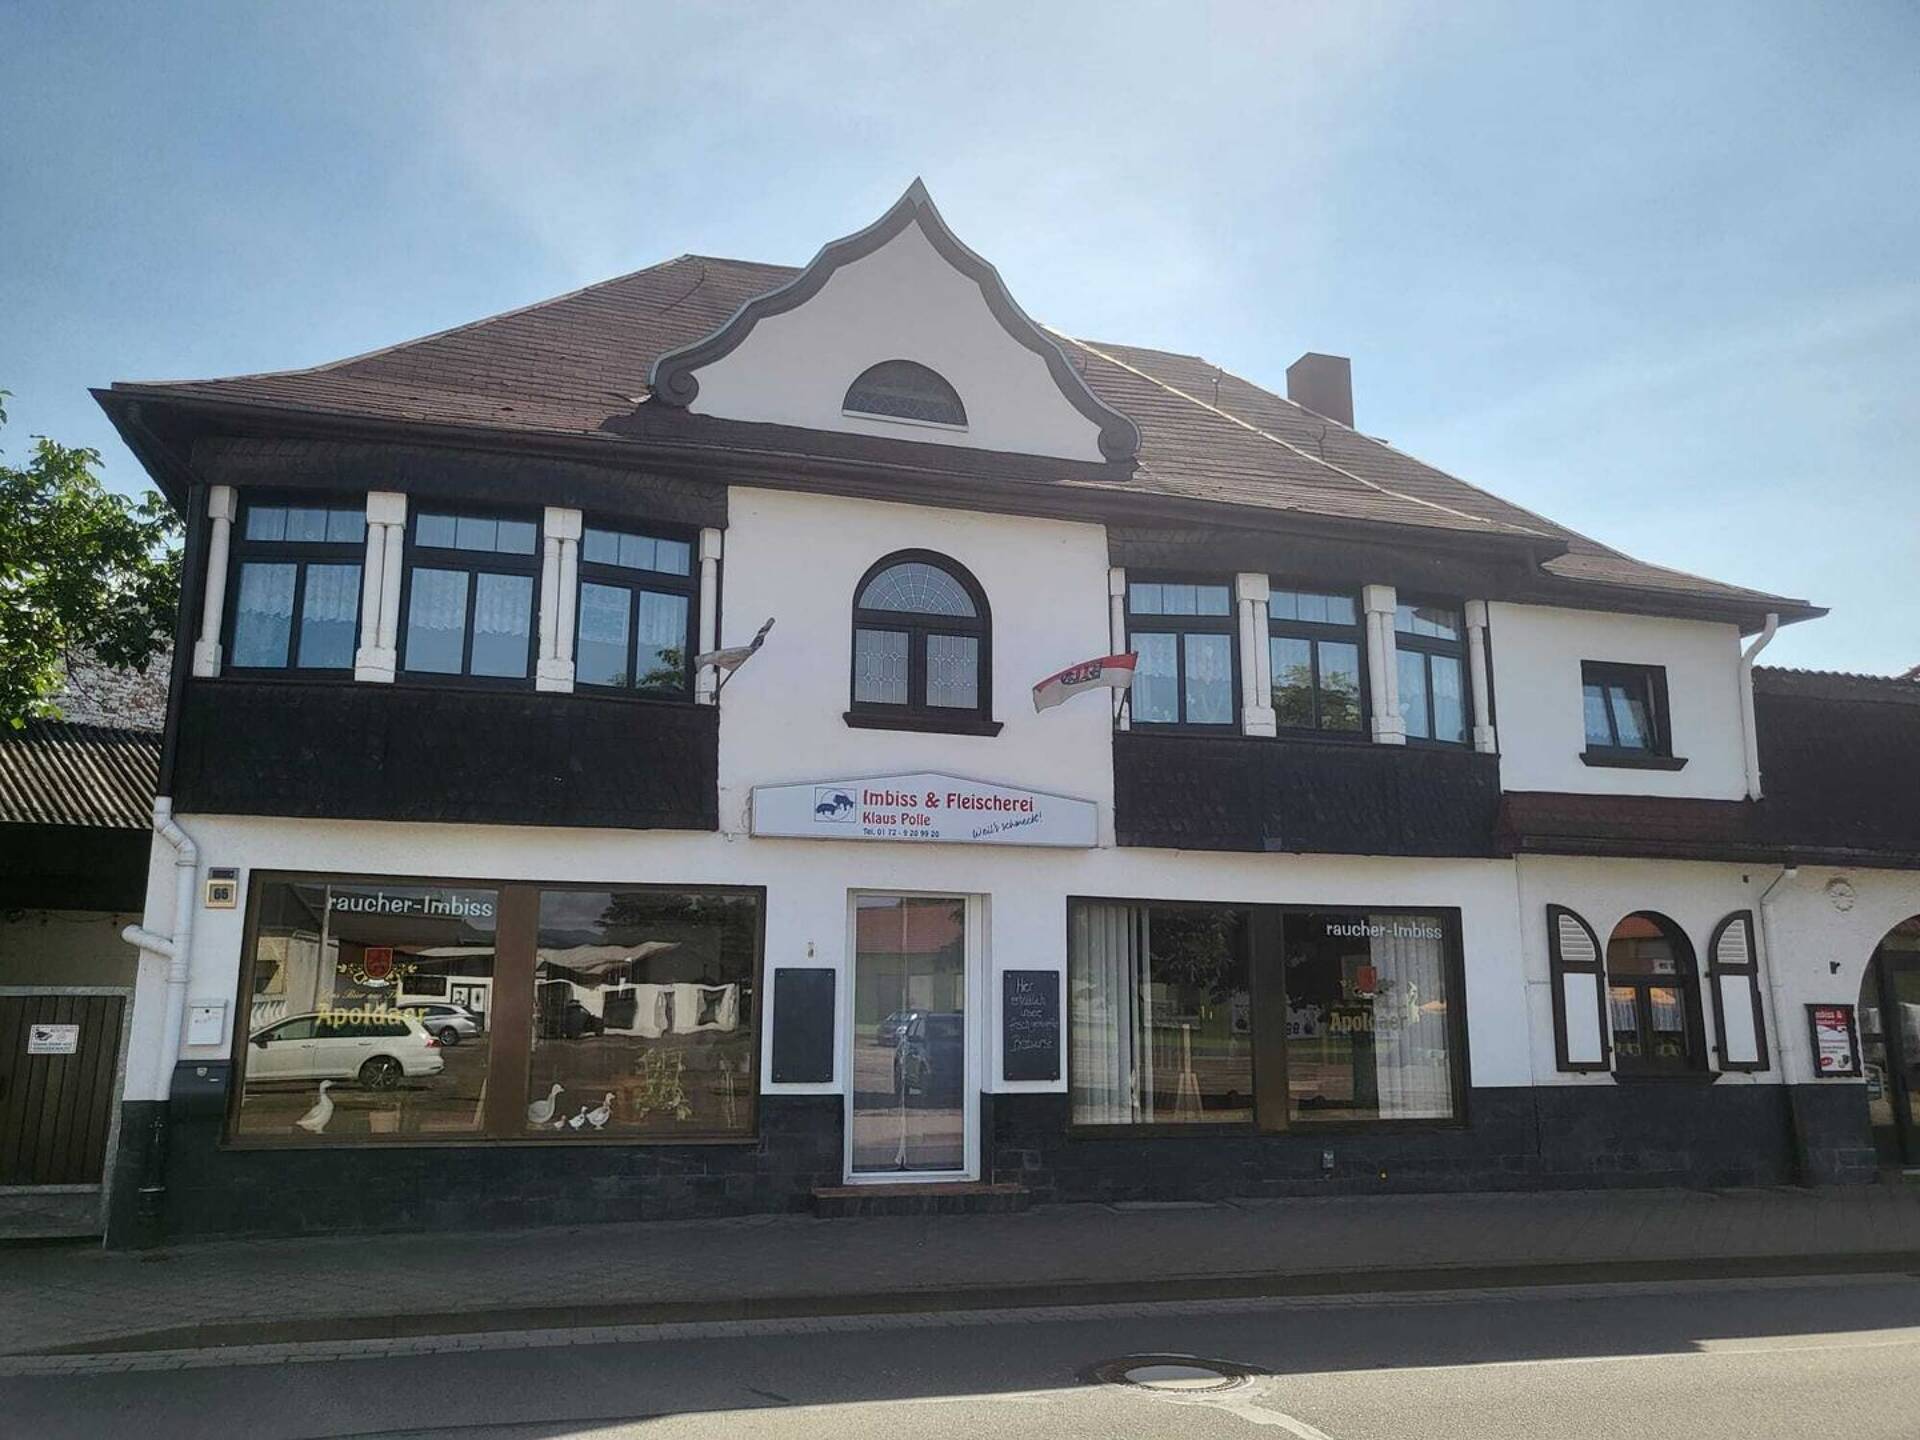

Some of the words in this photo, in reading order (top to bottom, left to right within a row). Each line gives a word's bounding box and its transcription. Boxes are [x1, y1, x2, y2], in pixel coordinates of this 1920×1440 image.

[863, 789, 917, 808] Imbiss
[925, 792, 940, 808] &
[947, 793, 1033, 812] Fleischerei
[863, 811, 897, 825] Klaus
[901, 812, 931, 826] Polle
[863, 827, 875, 836] Tel.
[328, 892, 493, 917] raucher-Imbiss
[1326, 920, 1443, 939] raucher-Imbiss
[315, 1001, 427, 1029] Apoldaer
